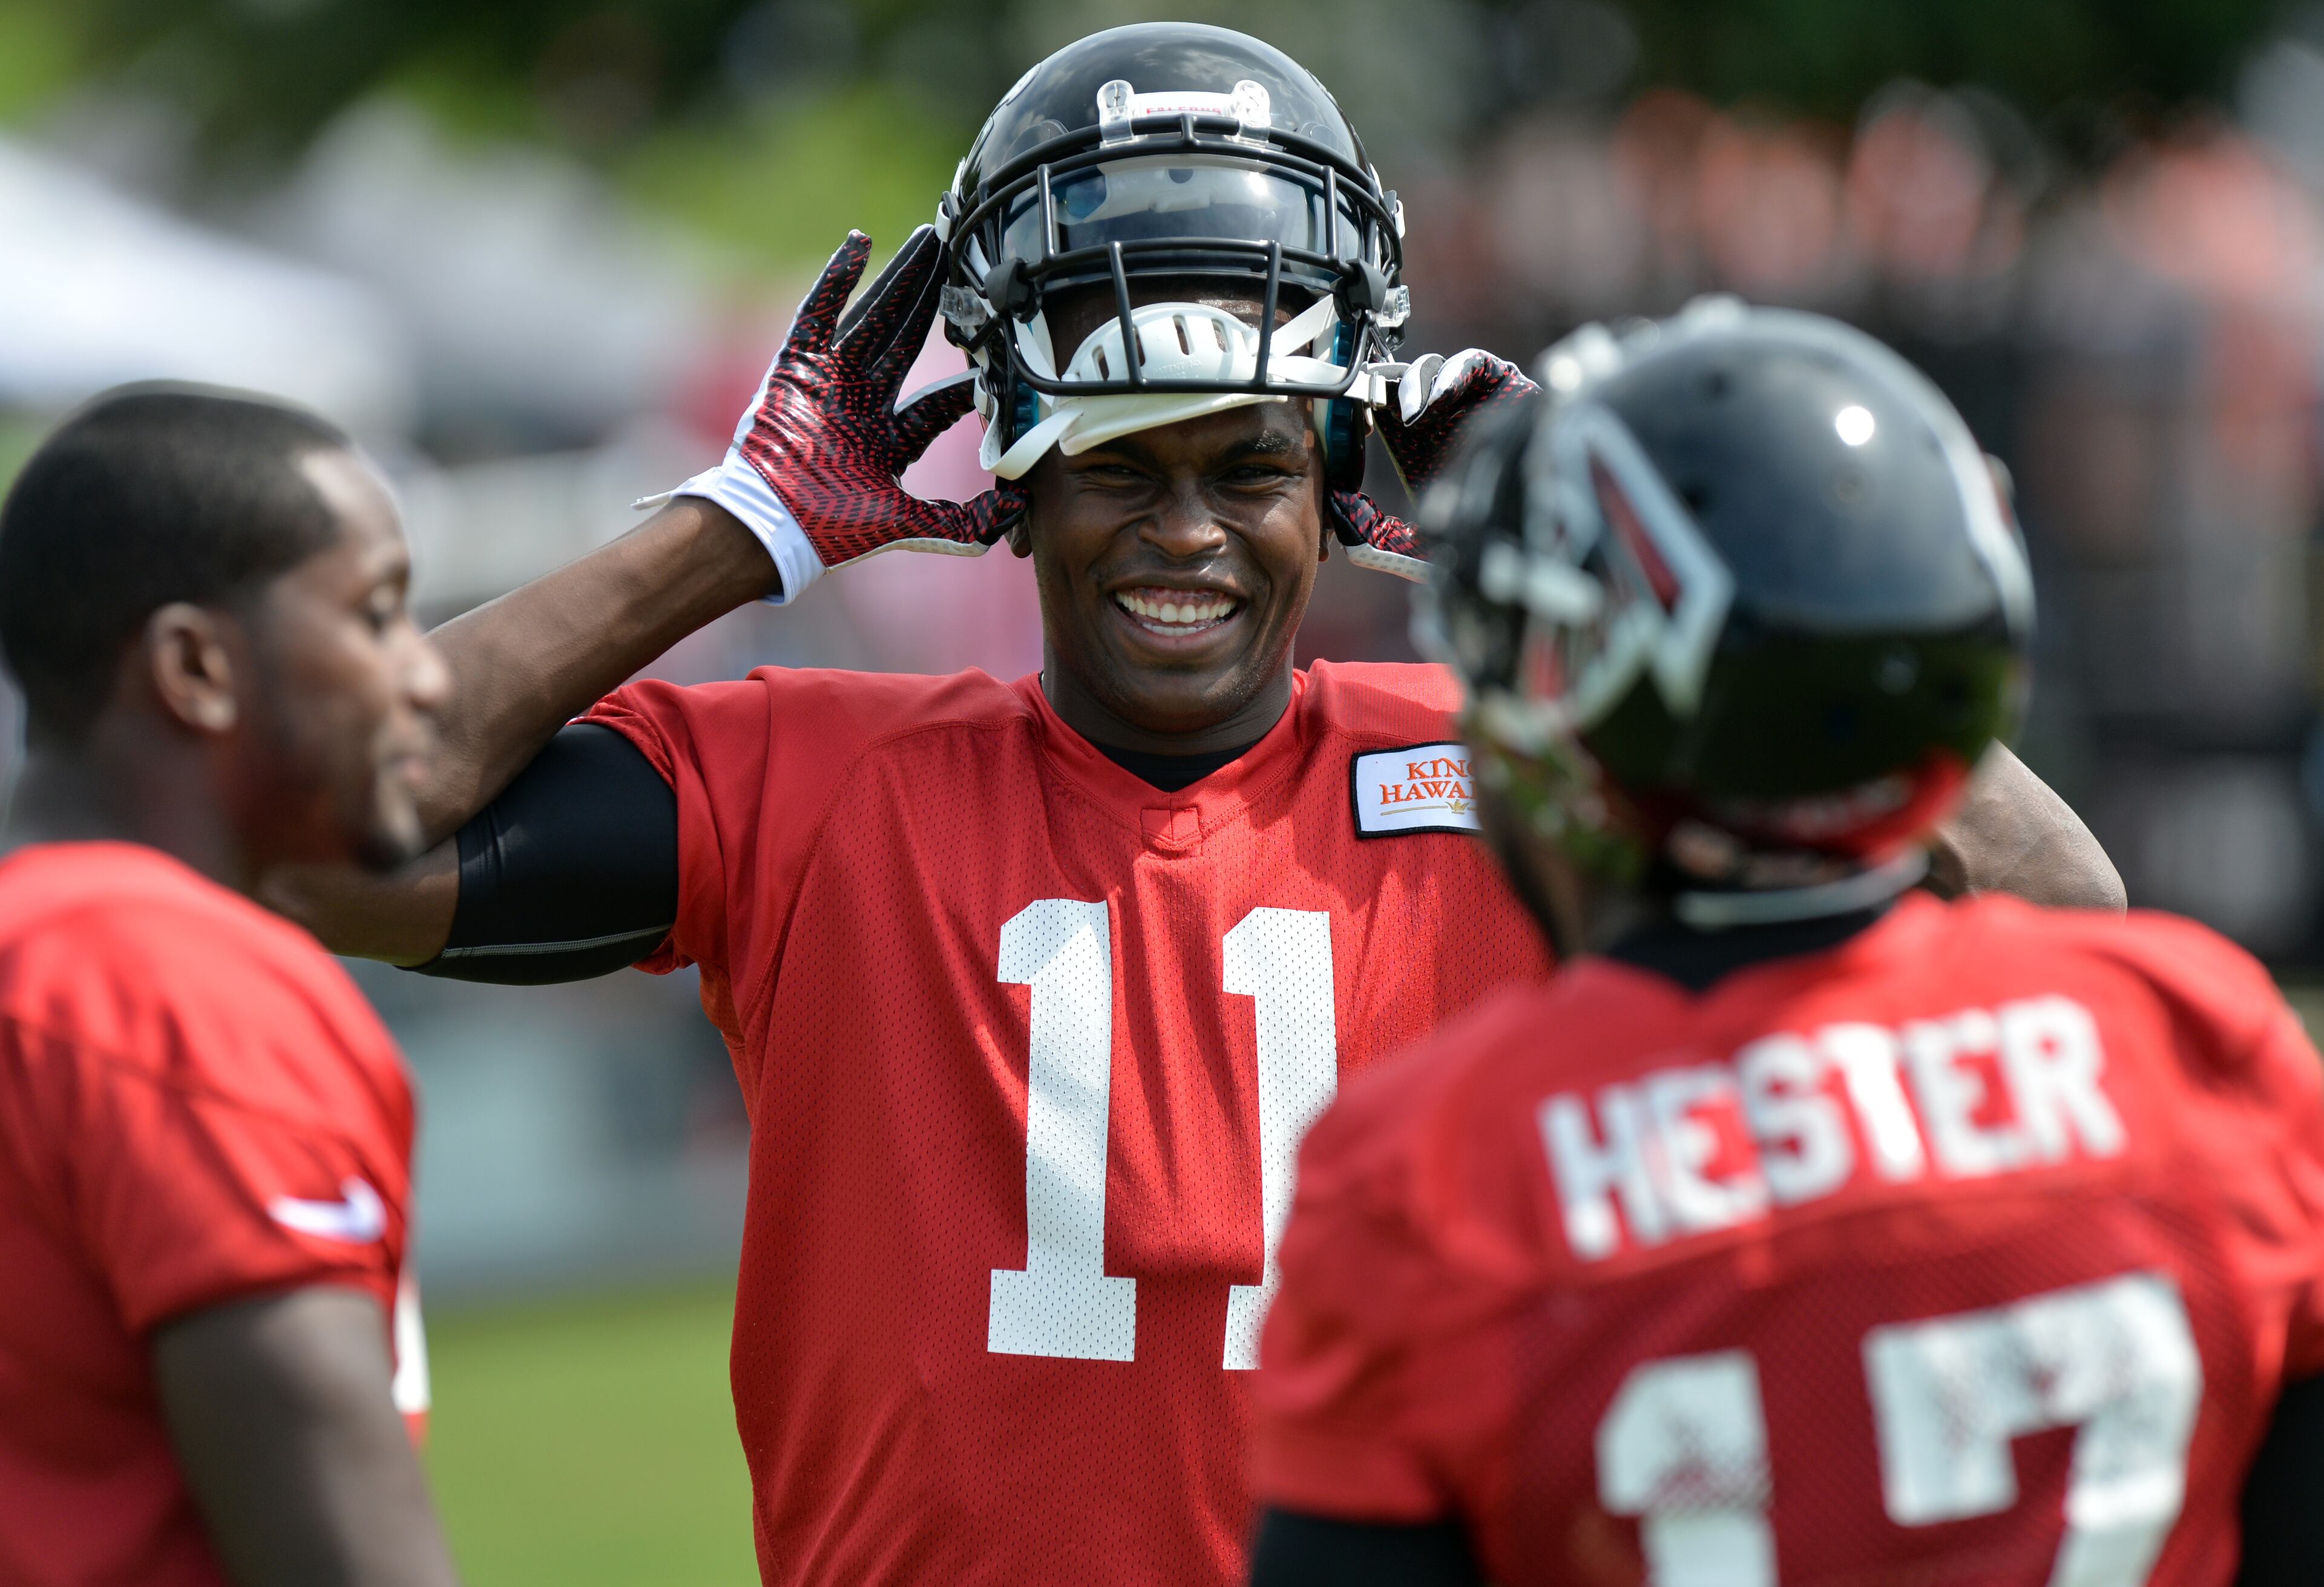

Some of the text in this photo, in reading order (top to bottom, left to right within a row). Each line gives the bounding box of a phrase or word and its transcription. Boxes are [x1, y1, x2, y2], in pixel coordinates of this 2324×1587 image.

[988, 899, 1338, 1370] 11
[1538, 994, 2127, 1261] HESTER
[1594, 1269, 2204, 1587] 17
